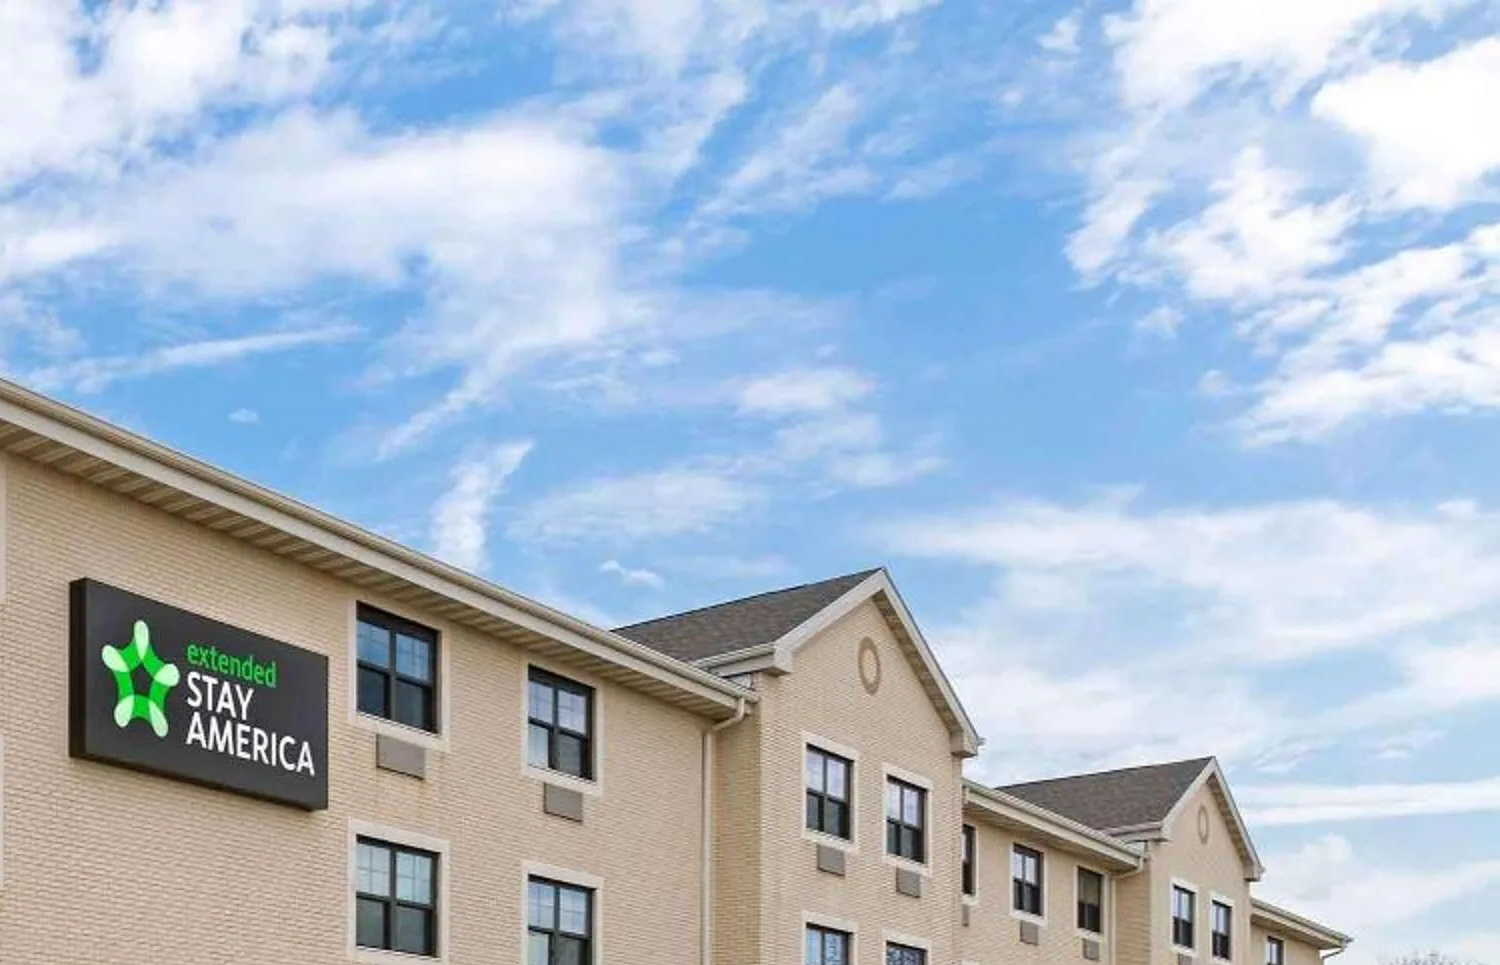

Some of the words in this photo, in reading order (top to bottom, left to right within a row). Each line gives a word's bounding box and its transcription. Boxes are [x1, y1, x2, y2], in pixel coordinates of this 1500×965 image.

[186, 642, 277, 688] extended
[186, 671, 254, 721] STAY
[185, 711, 315, 776] AMERICA
